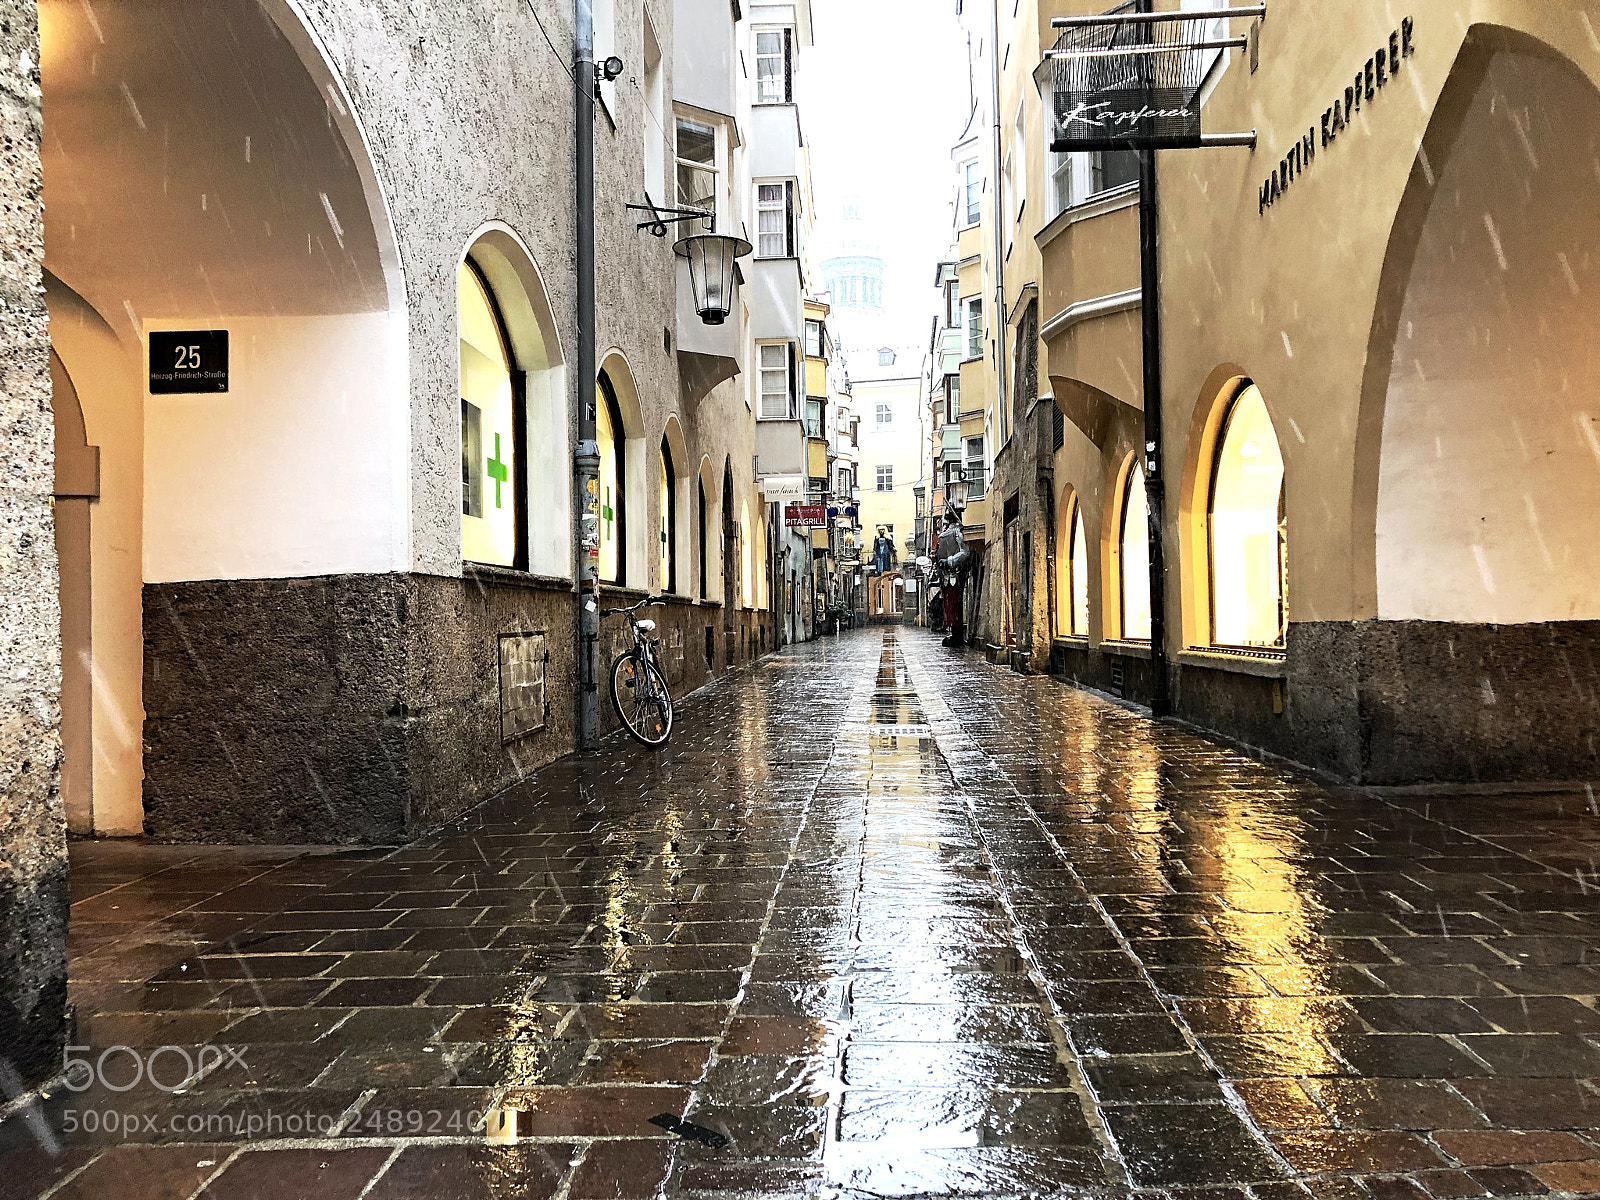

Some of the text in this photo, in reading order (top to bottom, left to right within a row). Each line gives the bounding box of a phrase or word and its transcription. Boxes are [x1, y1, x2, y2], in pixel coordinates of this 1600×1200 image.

[1061, 101, 1193, 130] Kapferer
[1259, 16, 1414, 215] MARTIN KAPFERER
[174, 345, 201, 369] 25
[150, 370, 226, 381] Herzog-Friedrich-Straße
